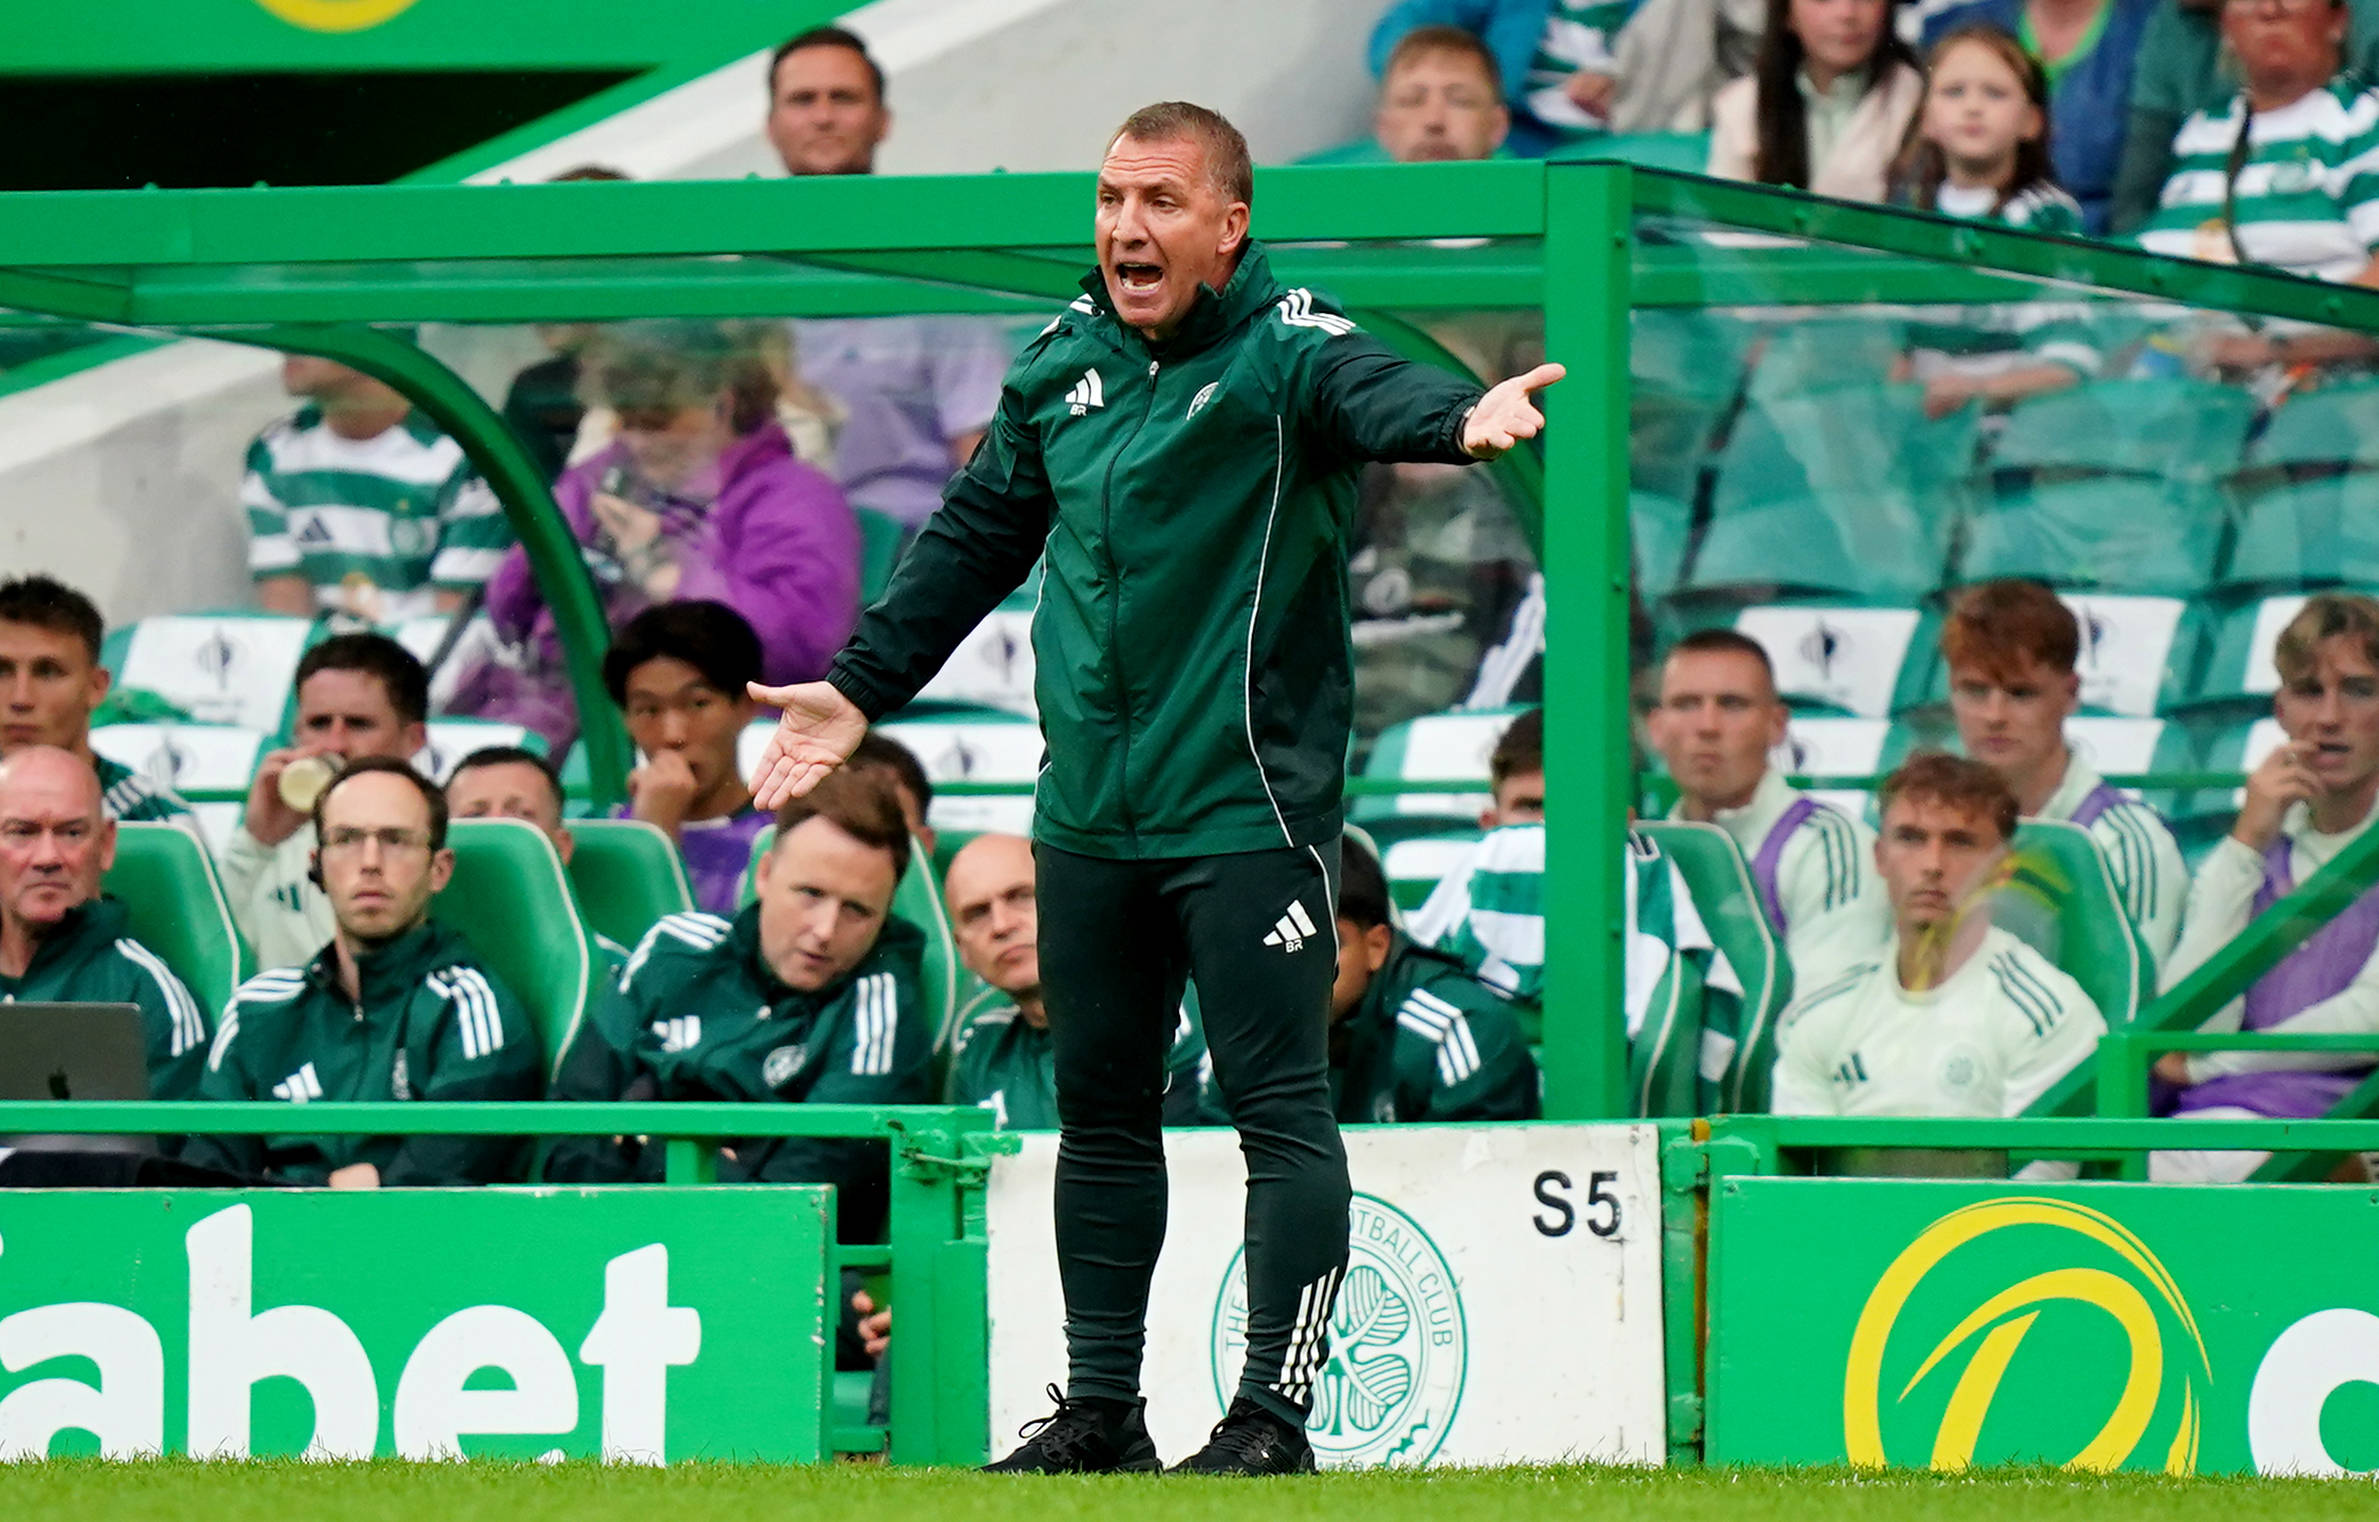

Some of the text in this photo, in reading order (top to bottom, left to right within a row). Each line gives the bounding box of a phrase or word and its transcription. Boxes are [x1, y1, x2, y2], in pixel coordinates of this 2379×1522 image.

[1070, 403, 1087, 416] BR
[1285, 940, 1303, 953] BR
[1533, 1170, 1622, 1237] S5
[1349, 1207, 1422, 1275] TBALL
[1418, 1272, 1453, 1346] CLUB
[0, 1203, 701, 1466] abet
